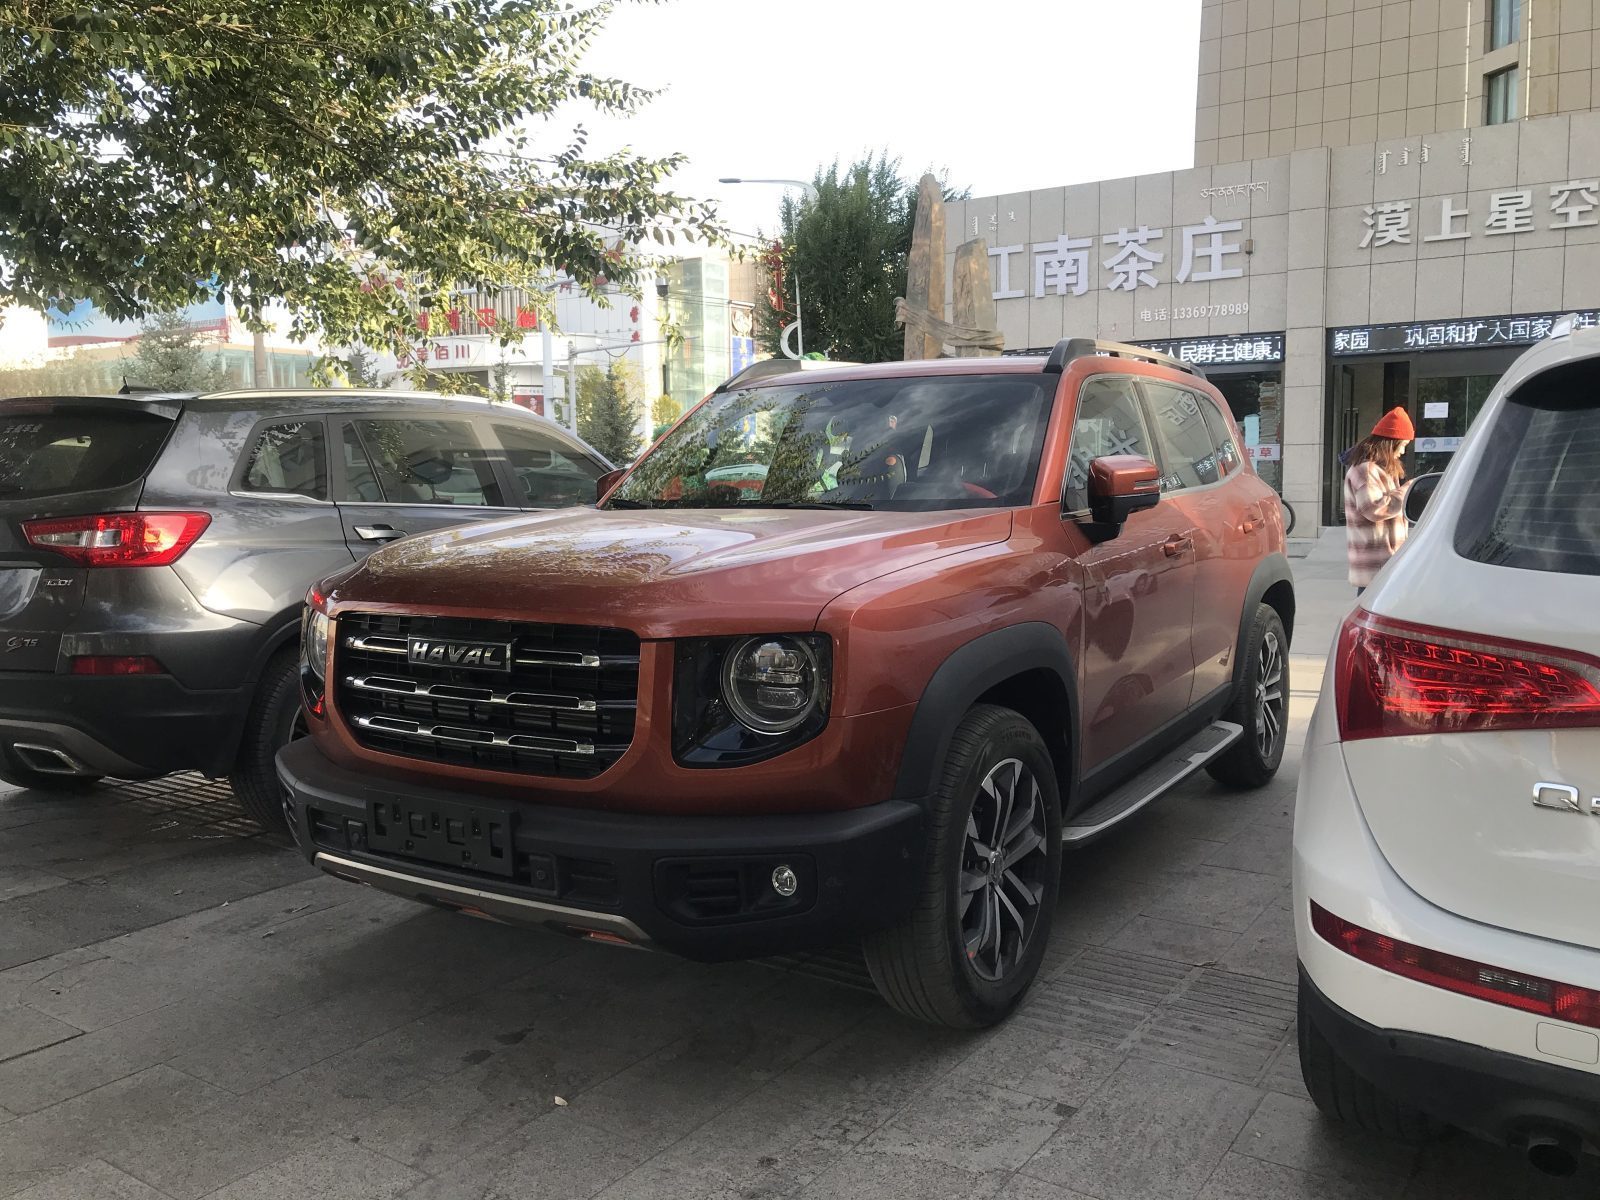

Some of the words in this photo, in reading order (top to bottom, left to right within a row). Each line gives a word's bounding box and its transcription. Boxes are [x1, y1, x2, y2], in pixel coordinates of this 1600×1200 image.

[1358, 180, 1600, 249] 漠上星空
[1334, 330, 1369, 349] 家园
[411, 641, 502, 666] HAVAL
